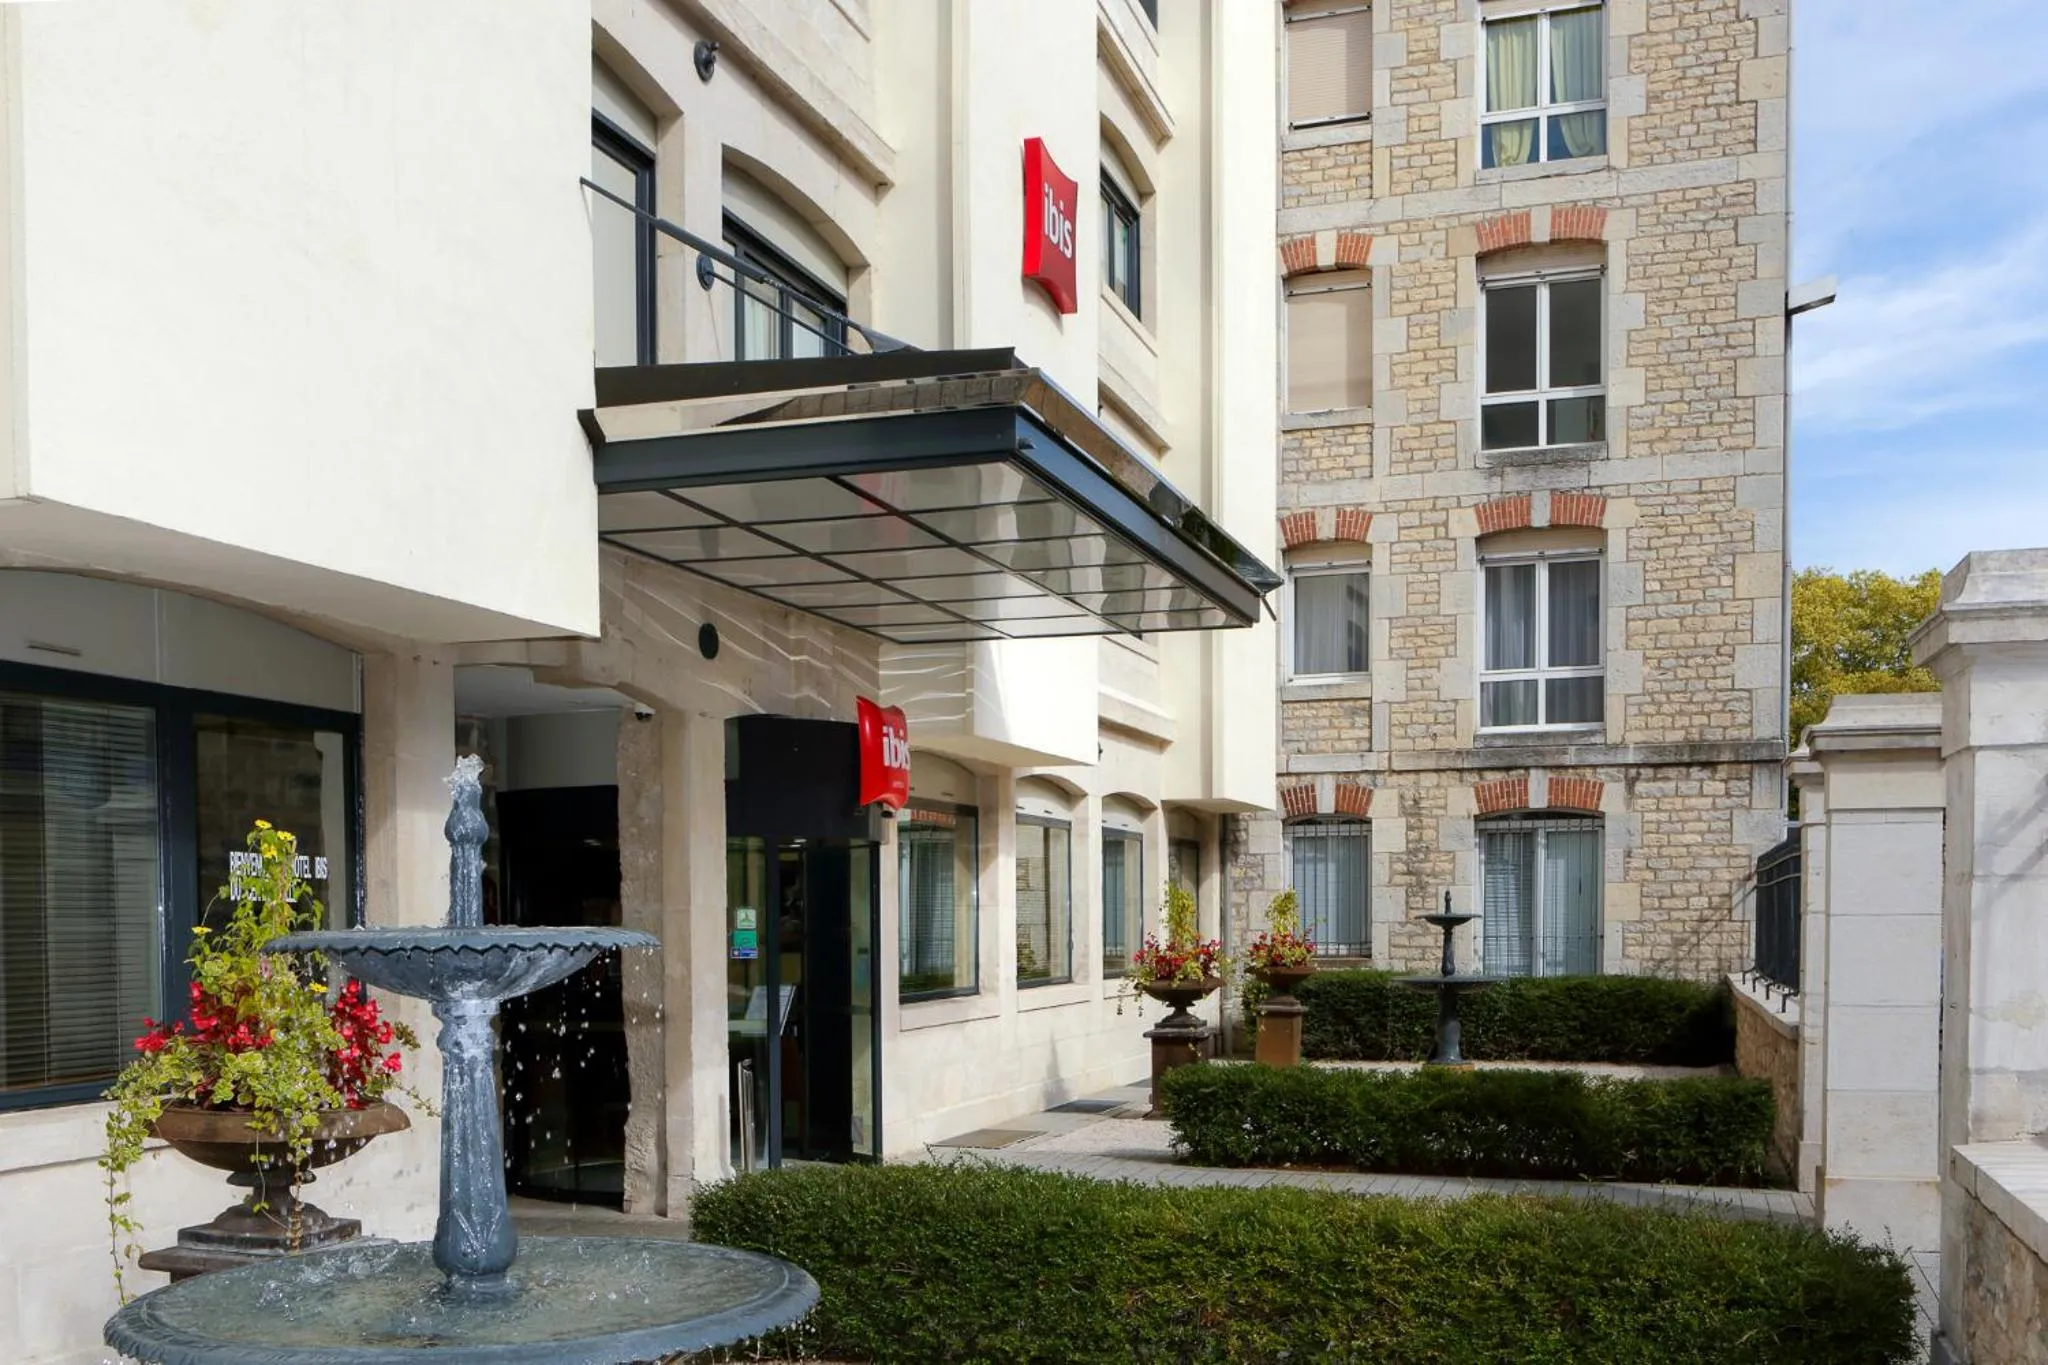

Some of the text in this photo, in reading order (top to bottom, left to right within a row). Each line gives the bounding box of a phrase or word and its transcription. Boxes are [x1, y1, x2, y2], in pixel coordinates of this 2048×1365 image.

[1044, 181, 1073, 259] ibis
[882, 725, 910, 771] ibis
[314, 856, 328, 880] IBIS
